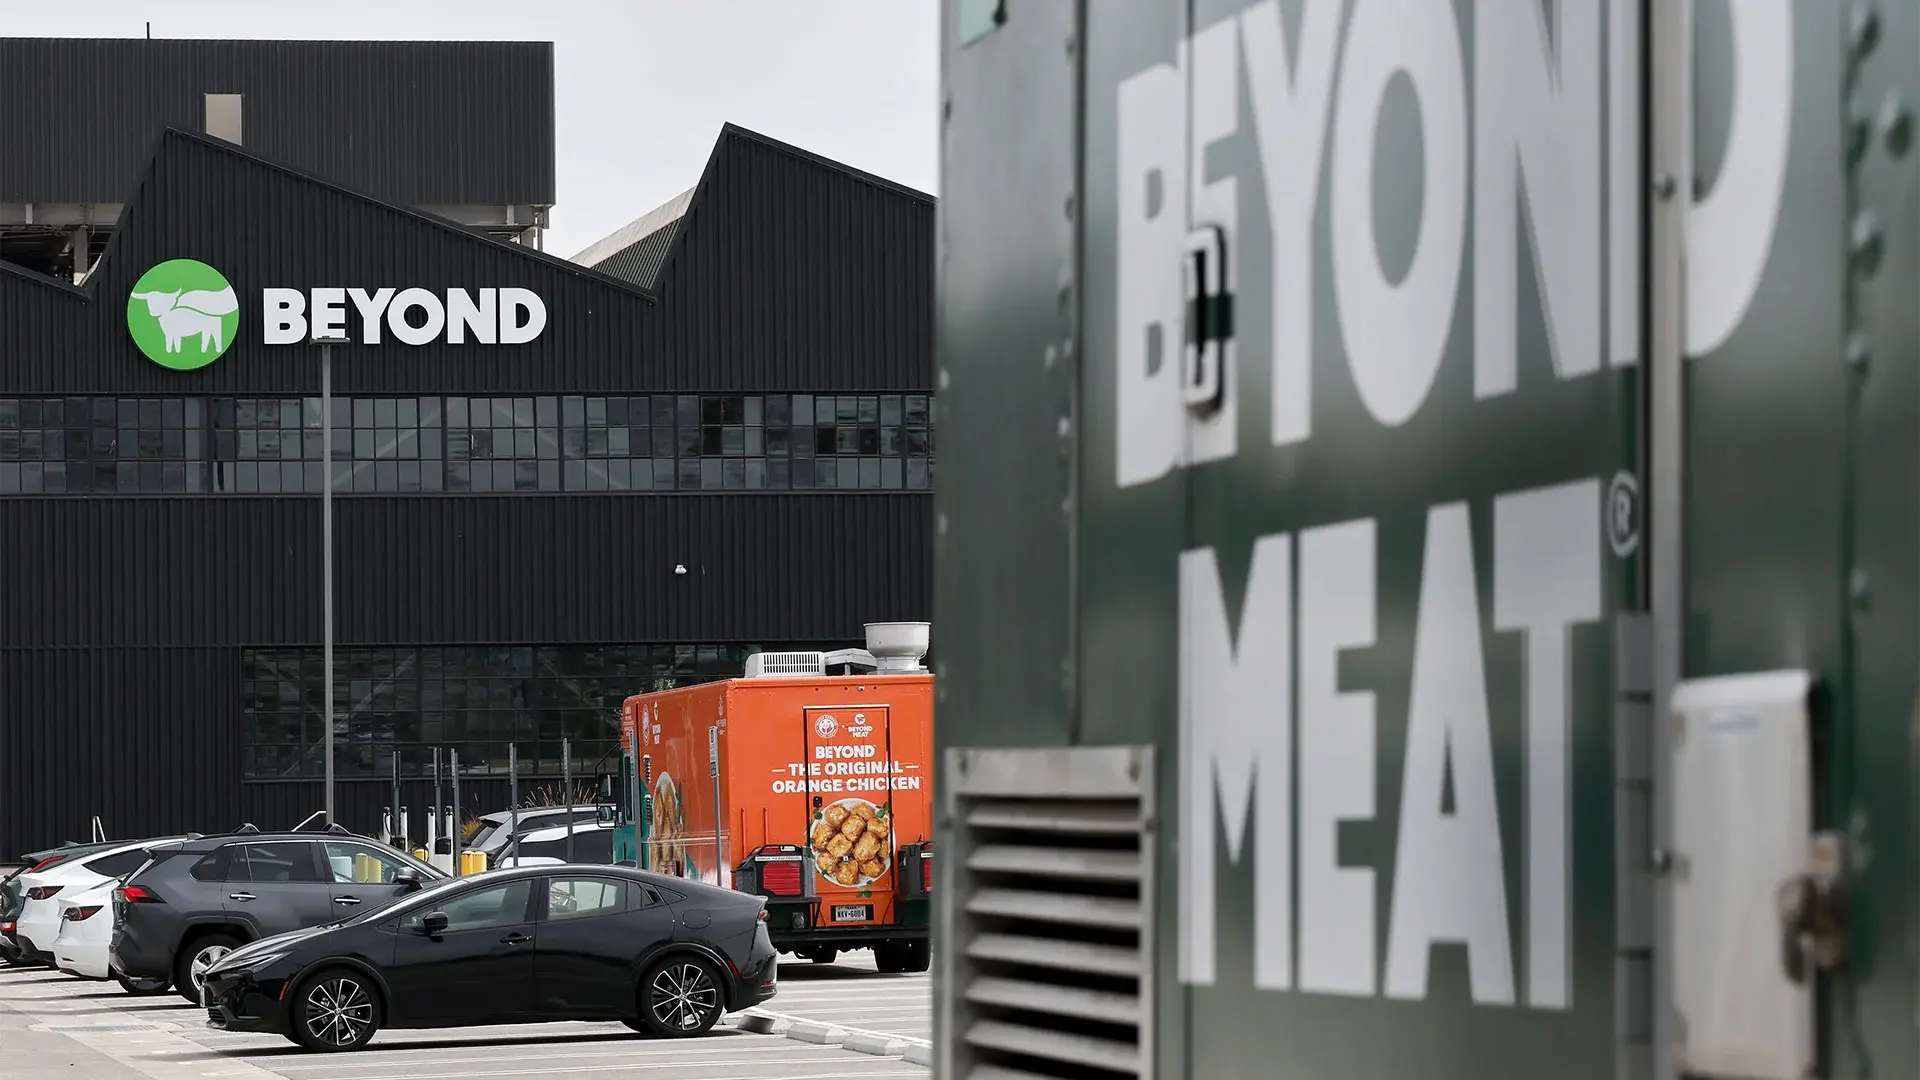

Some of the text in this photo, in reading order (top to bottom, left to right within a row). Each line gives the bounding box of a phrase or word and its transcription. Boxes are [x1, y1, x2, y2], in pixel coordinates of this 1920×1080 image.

[1116, 0, 1792, 488] BEYOND
[263, 287, 547, 346] BEYOND
[848, 725, 873, 733] BEYOND
[815, 744, 875, 759] BEYOND
[788, 760, 904, 777] THE ORIGINAL
[772, 776, 920, 794] ORANGE CHICKEN
